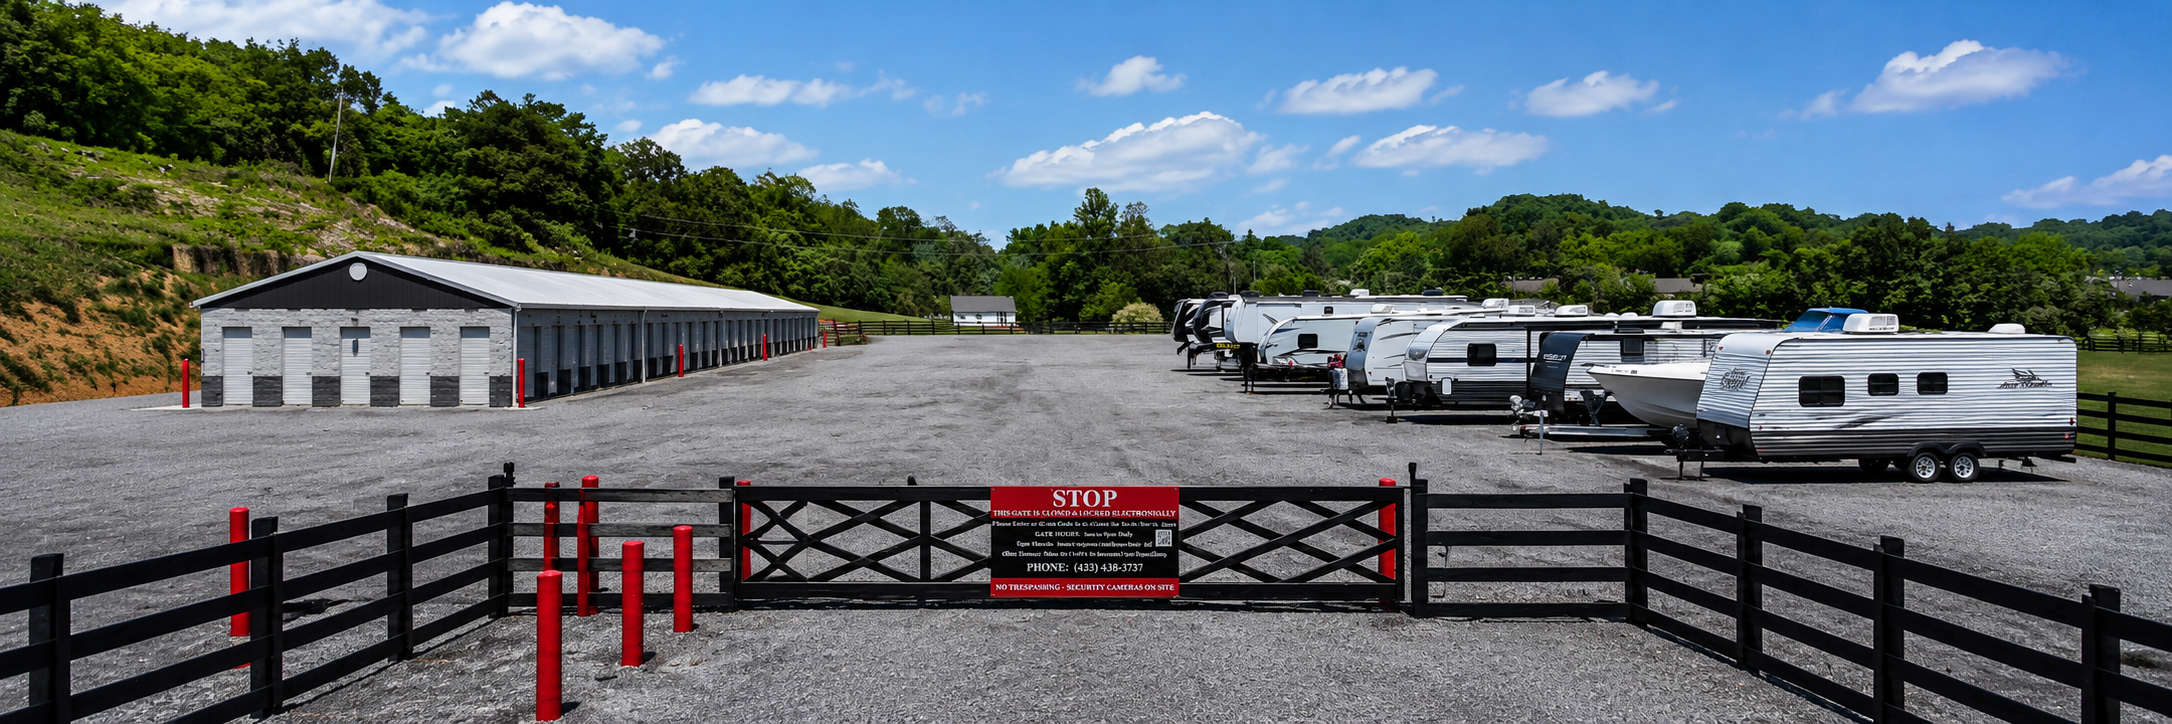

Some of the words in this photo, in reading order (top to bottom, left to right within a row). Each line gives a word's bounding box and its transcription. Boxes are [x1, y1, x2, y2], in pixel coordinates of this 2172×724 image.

[1052, 489, 1118, 508] STOP
[1027, 563, 1068, 572] PHONE:
[1074, 562, 1098, 573] (433)
[1100, 563, 1143, 572] 438-3737
